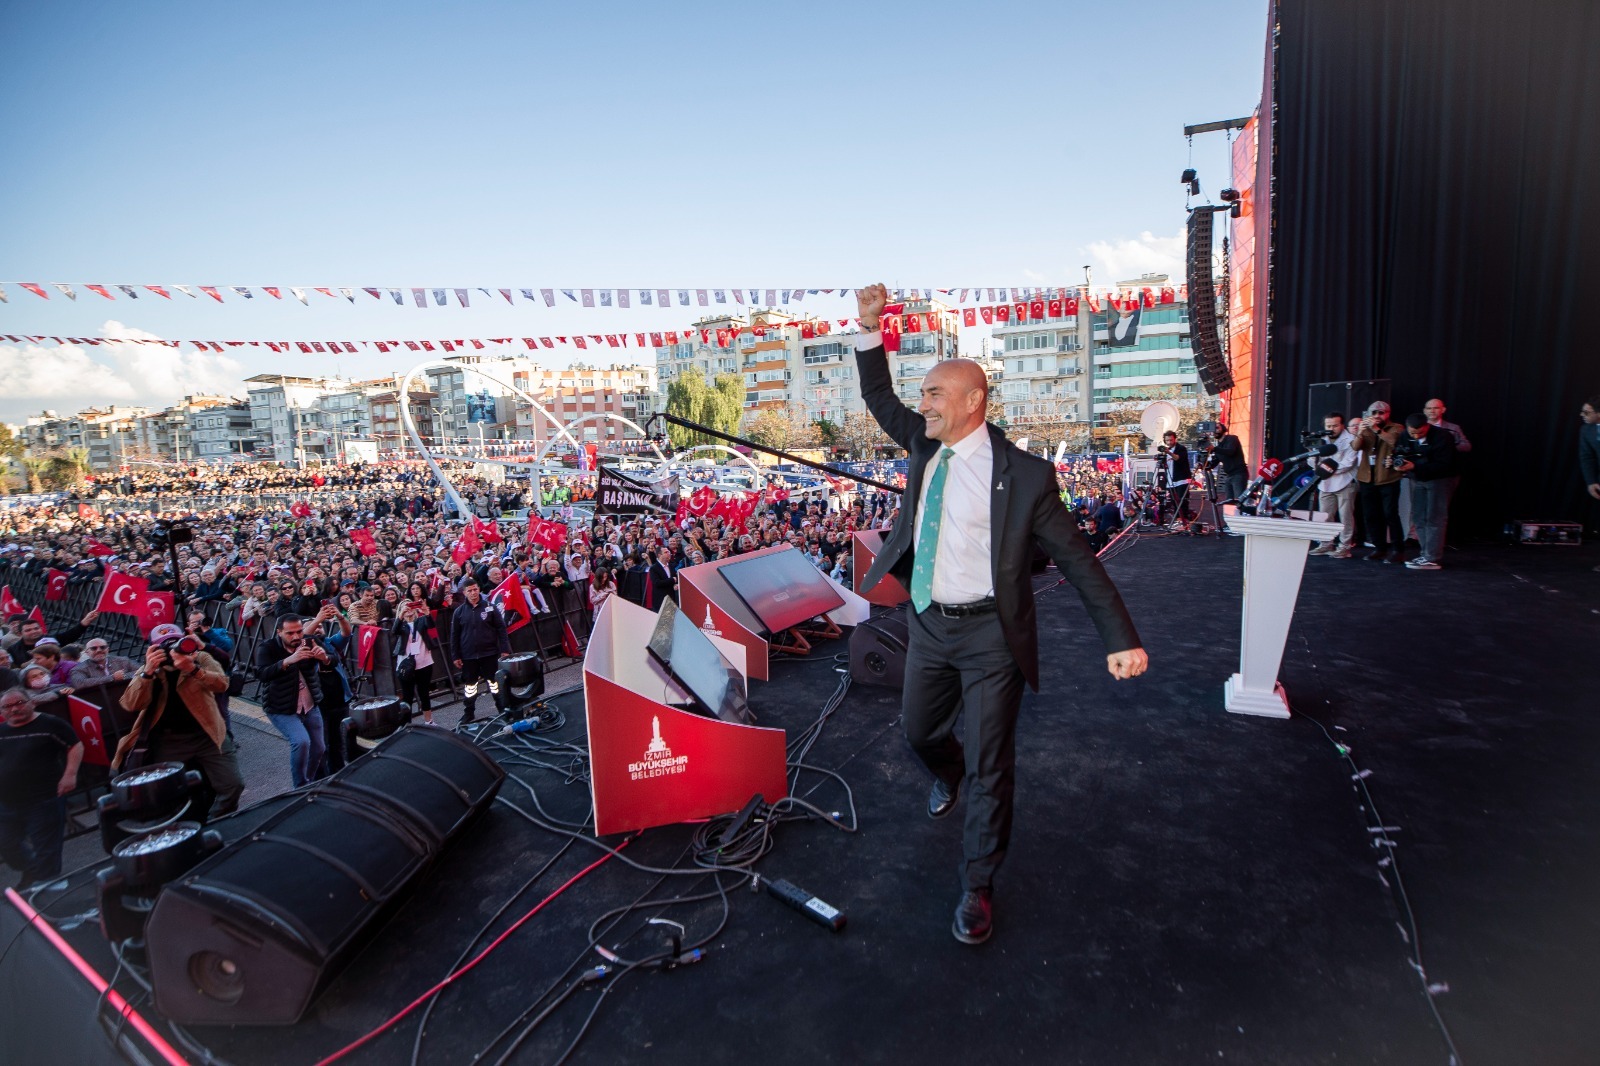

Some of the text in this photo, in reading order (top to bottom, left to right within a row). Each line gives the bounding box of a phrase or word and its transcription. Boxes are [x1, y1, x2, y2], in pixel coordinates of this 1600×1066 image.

[628, 755, 689, 773] BÜYÜKŞEHİR
[644, 750, 672, 761] İZMİR
[631, 764, 686, 781] BELEDİYESİ
